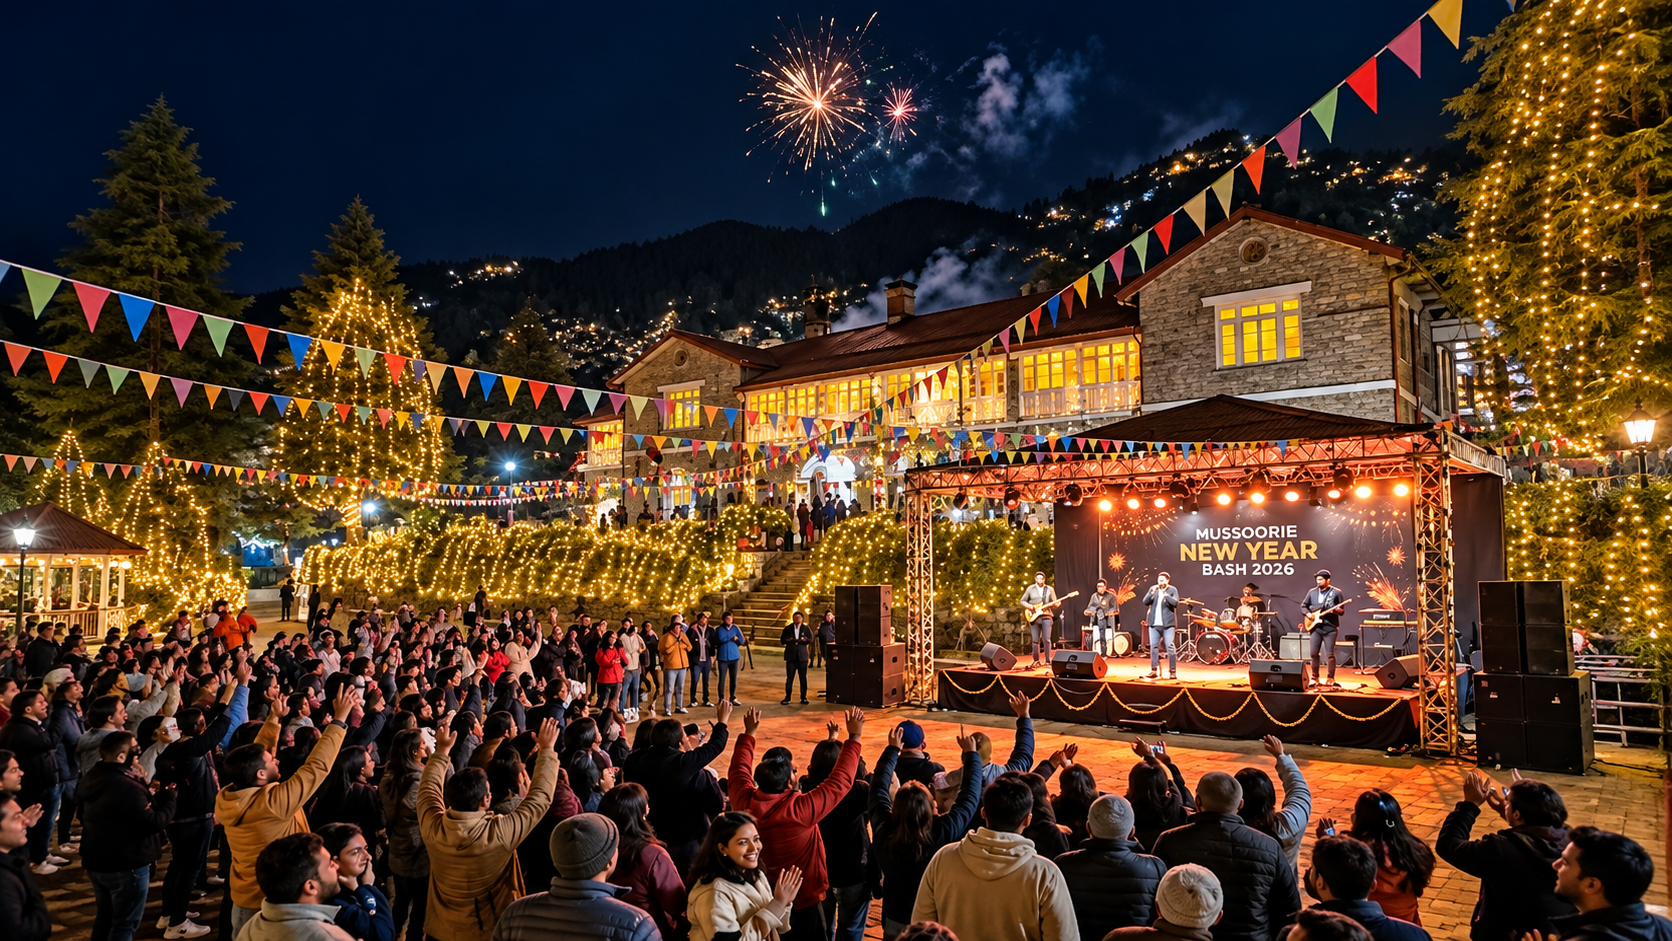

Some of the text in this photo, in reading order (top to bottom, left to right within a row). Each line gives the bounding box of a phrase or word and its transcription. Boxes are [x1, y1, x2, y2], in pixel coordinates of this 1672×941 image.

[1196, 525, 1297, 540] MUSSOORIE
[1180, 540, 1318, 561] NEW YEAR
[1202, 562, 1295, 576] BASH 2026
